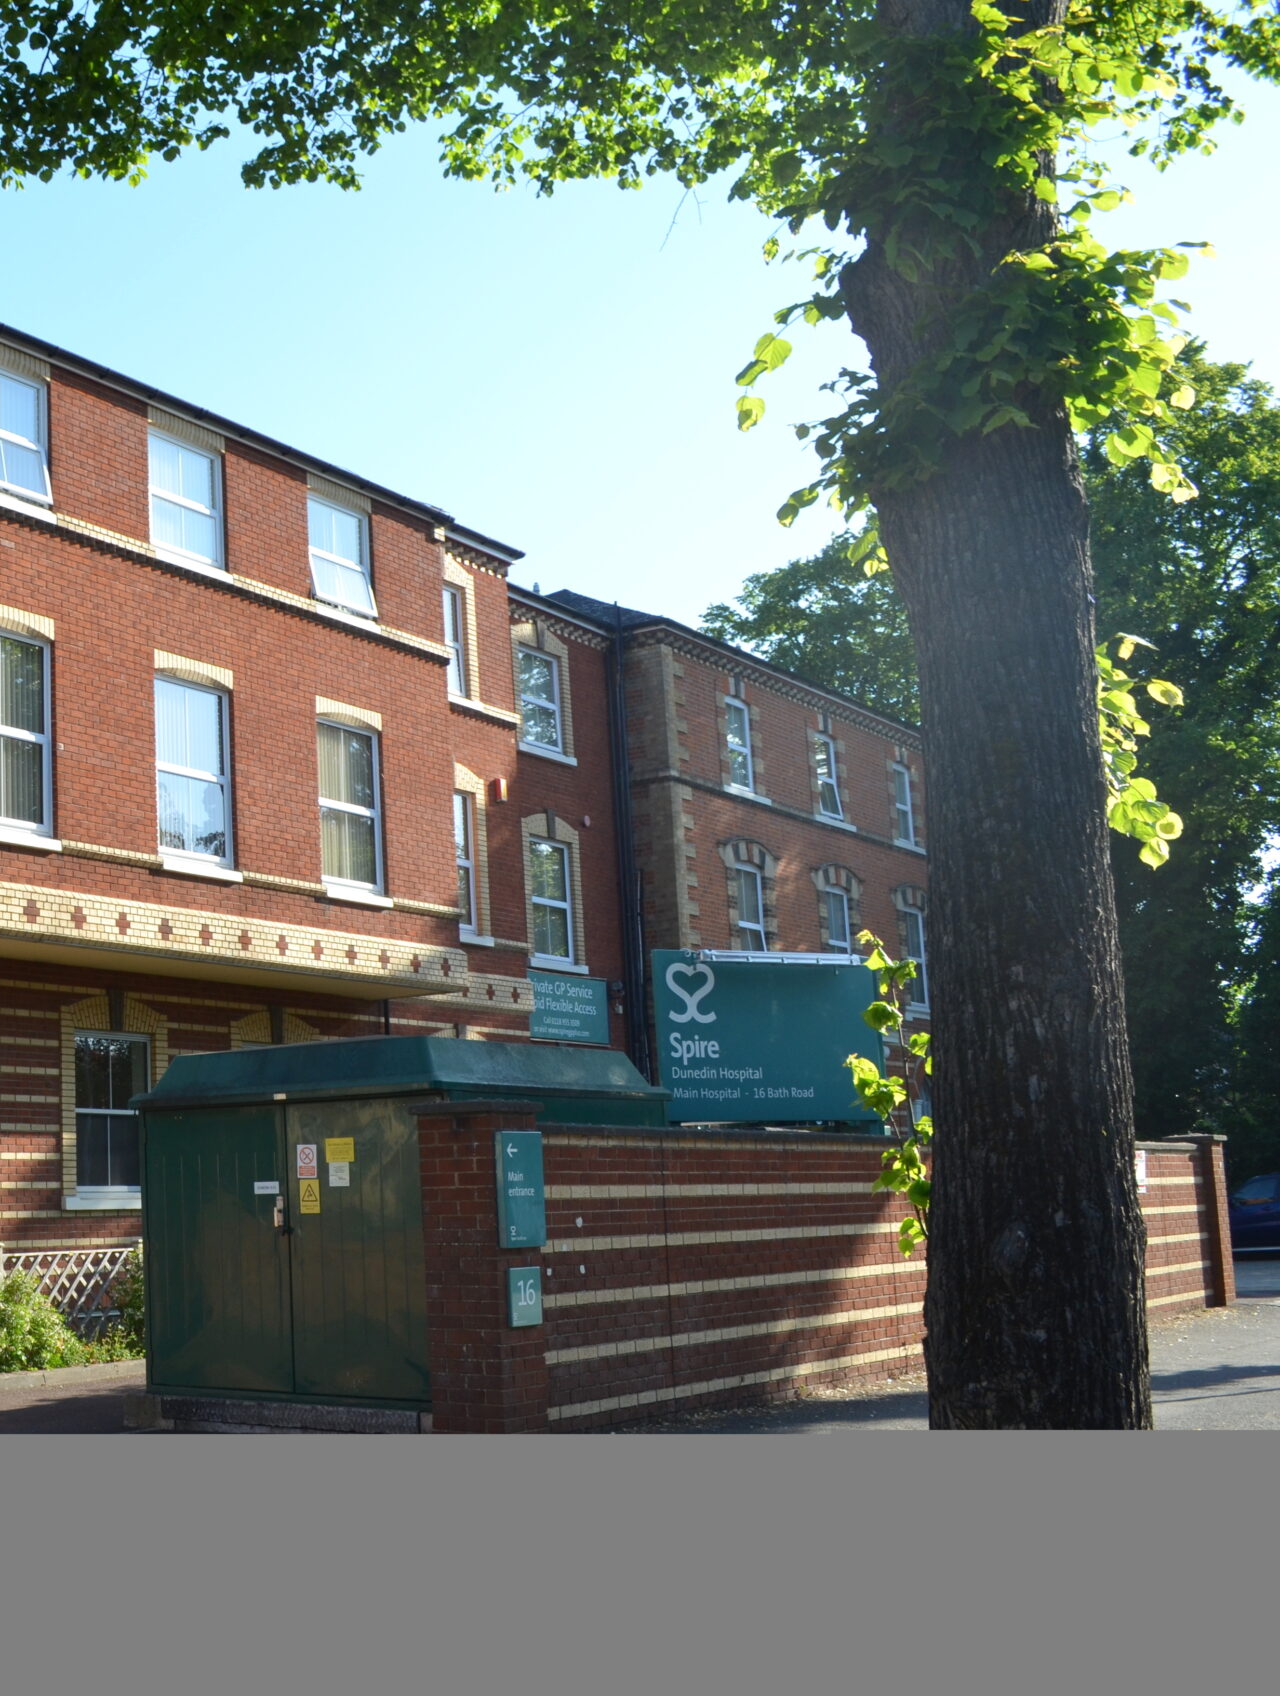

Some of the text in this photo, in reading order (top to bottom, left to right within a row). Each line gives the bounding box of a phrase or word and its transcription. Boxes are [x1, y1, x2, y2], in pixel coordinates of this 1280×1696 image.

[533, 979, 593, 999] ivate GP Service
[534, 996, 596, 1016] pid Flexible Access
[669, 1032, 720, 1066] Spire
[672, 1066, 763, 1082] Dunedin Hospital
[673, 1087, 698, 1098] Main
[701, 1087, 741, 1101] Hospital
[753, 1087, 766, 1098] 16
[767, 1087, 790, 1098] Bath
[791, 1087, 814, 1098] Road
[508, 1171, 524, 1181] Main
[508, 1186, 535, 1197] entrance
[517, 1279, 536, 1306] 16
